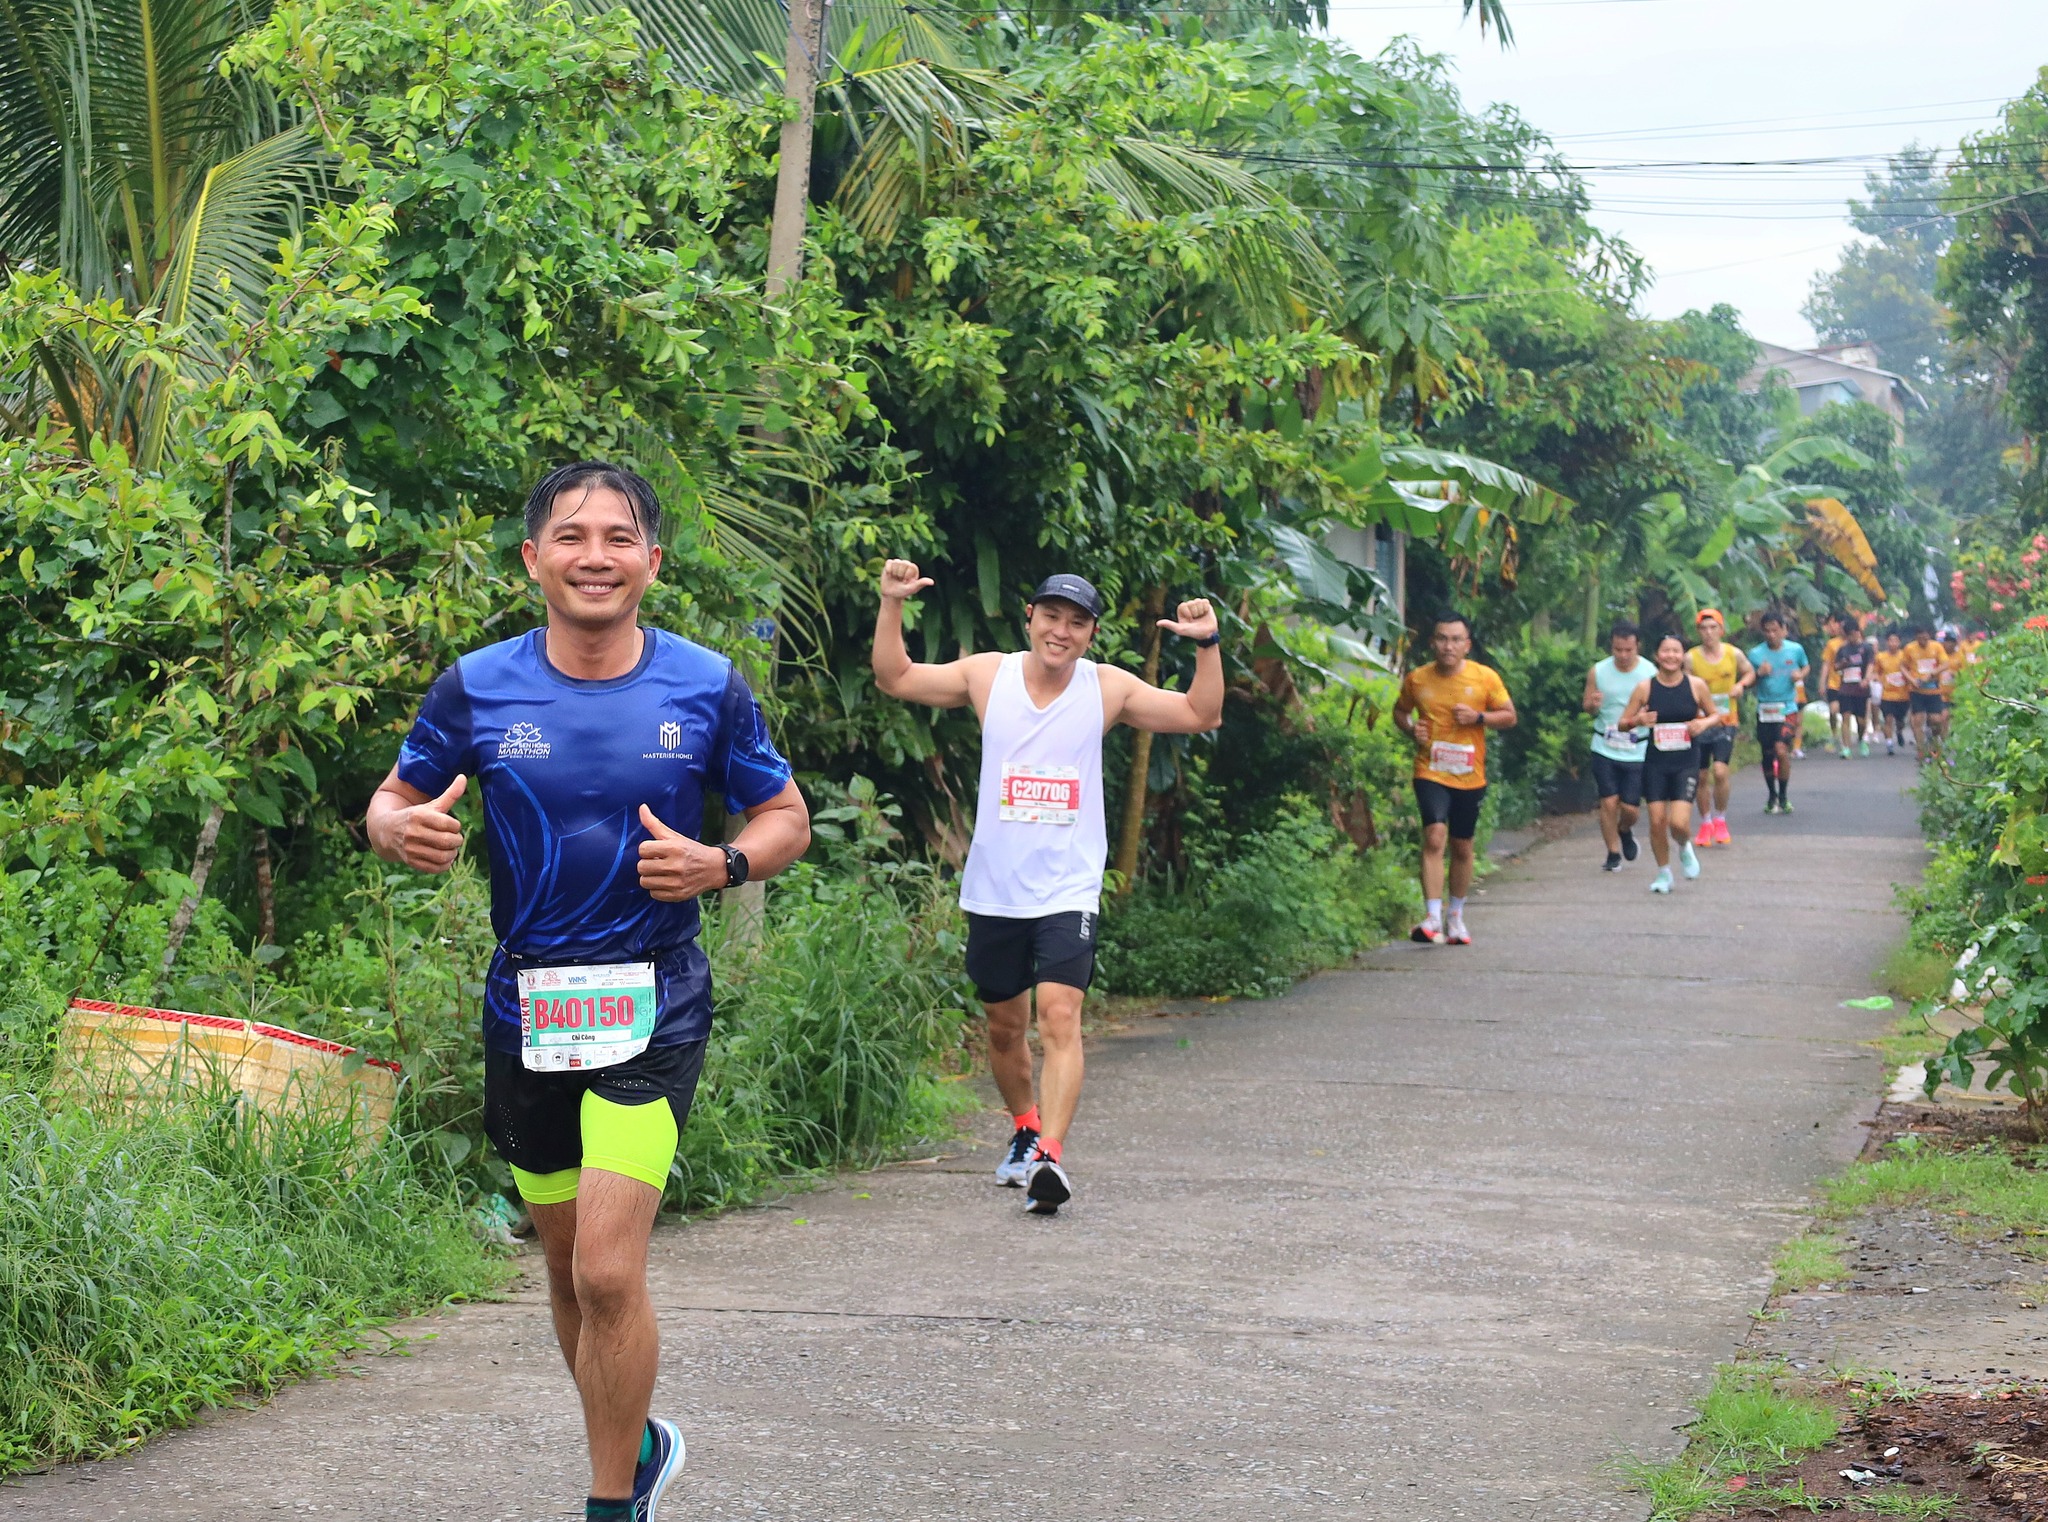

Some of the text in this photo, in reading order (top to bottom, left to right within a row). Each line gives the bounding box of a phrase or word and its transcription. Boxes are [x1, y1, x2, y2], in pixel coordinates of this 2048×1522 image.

[1011, 779, 1071, 802] C20706
[568, 976, 588, 984] VNMS
[521, 998, 531, 1032] 42KM
[534, 995, 635, 1030] B40150
